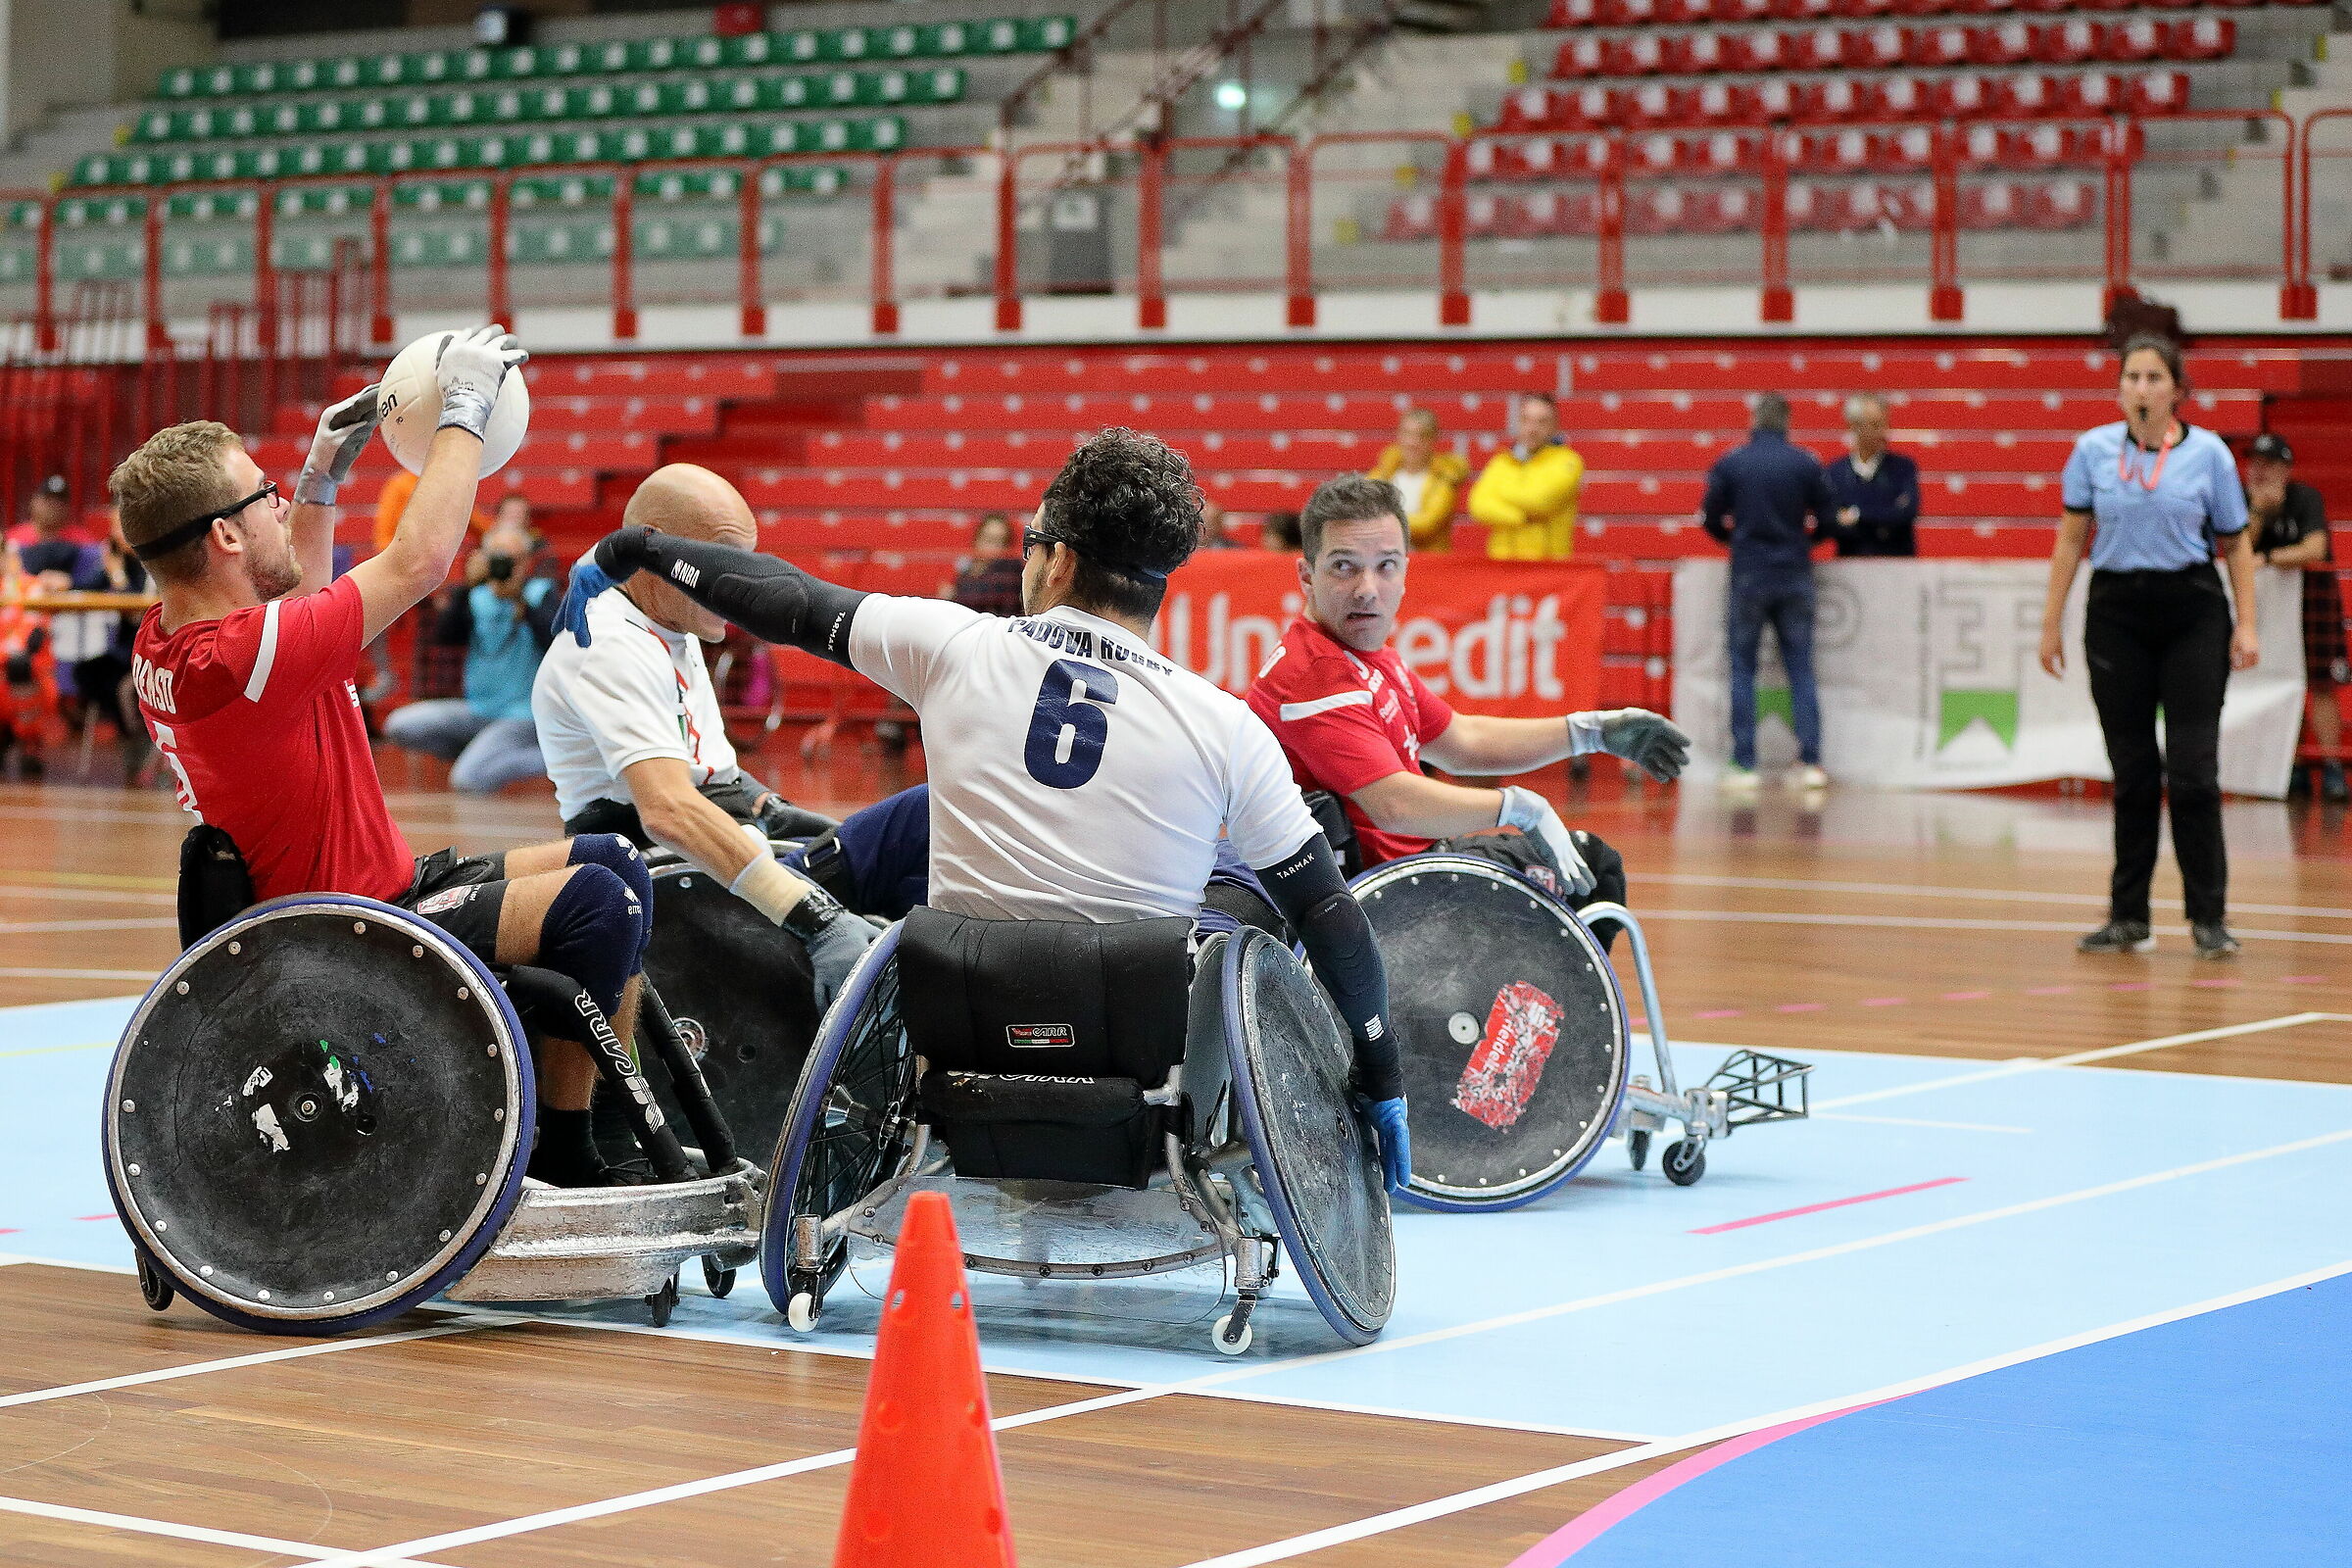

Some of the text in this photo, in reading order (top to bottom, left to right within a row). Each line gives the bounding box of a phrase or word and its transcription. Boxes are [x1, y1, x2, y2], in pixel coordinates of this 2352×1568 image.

[677, 562, 701, 588] NBA
[827, 611, 847, 652] TARMAK
[1007, 619, 1093, 658] PADOVA
[1024, 659, 1118, 790] 6
[1277, 853, 1315, 879] TARMAK
